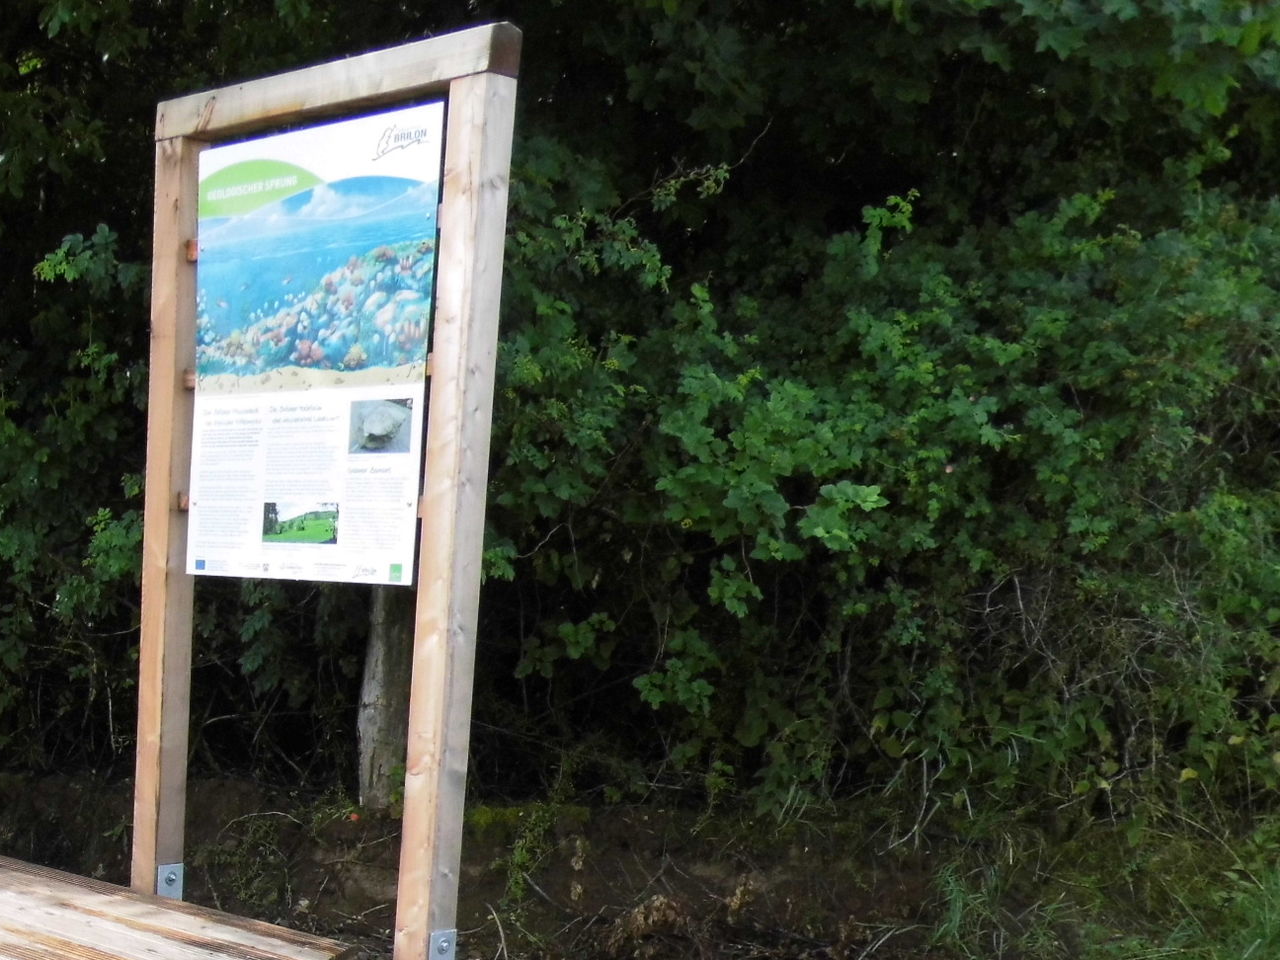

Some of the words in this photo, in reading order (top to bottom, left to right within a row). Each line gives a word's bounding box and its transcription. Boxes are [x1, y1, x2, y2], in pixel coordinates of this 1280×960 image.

[394, 128, 427, 143] BRILON
[207, 182, 263, 200] GEOLOGISCHER
[264, 176, 298, 191] SPRUNG
